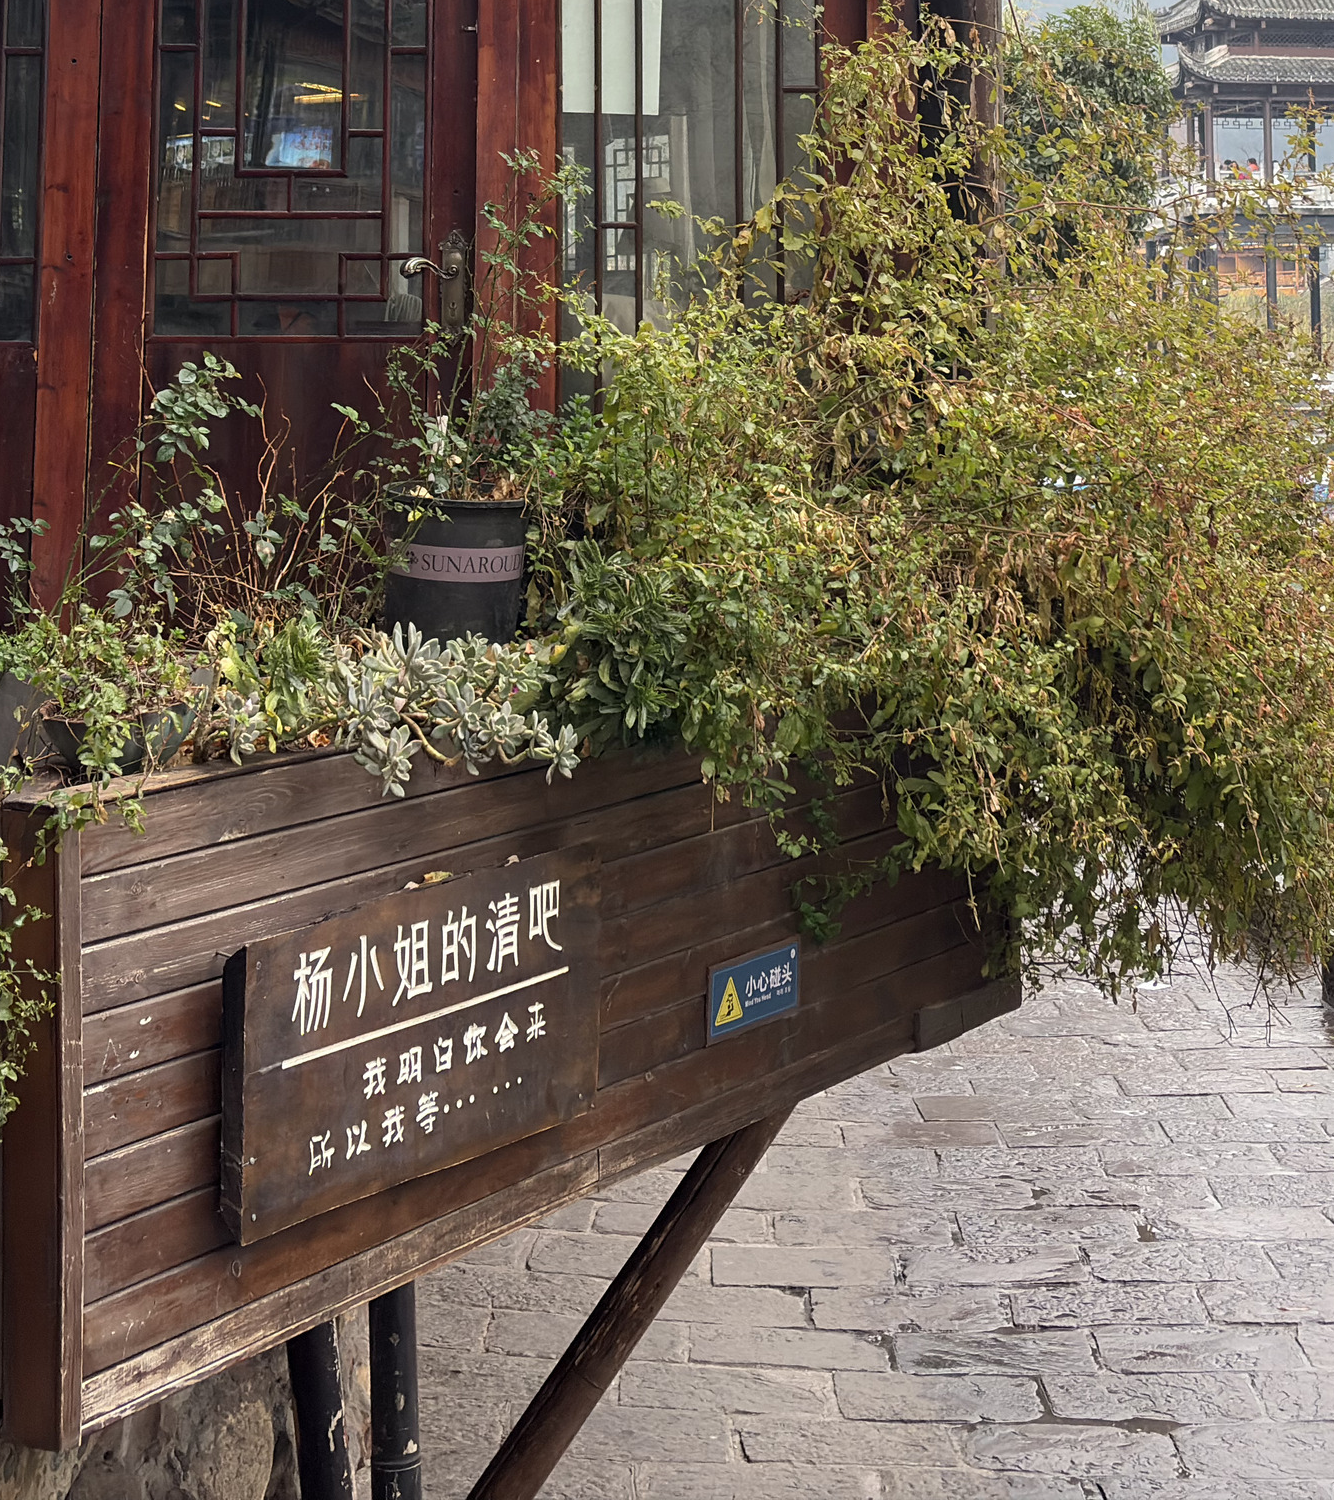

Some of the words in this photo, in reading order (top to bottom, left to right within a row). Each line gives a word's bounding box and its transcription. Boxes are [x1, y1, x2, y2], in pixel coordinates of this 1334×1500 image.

[421, 553, 521, 574] SUNAROUD
[291, 879, 563, 1037] 杨小姐的清吧
[745, 962, 793, 997] 小心碰头
[362, 1001, 547, 1100] 我明白你会来
